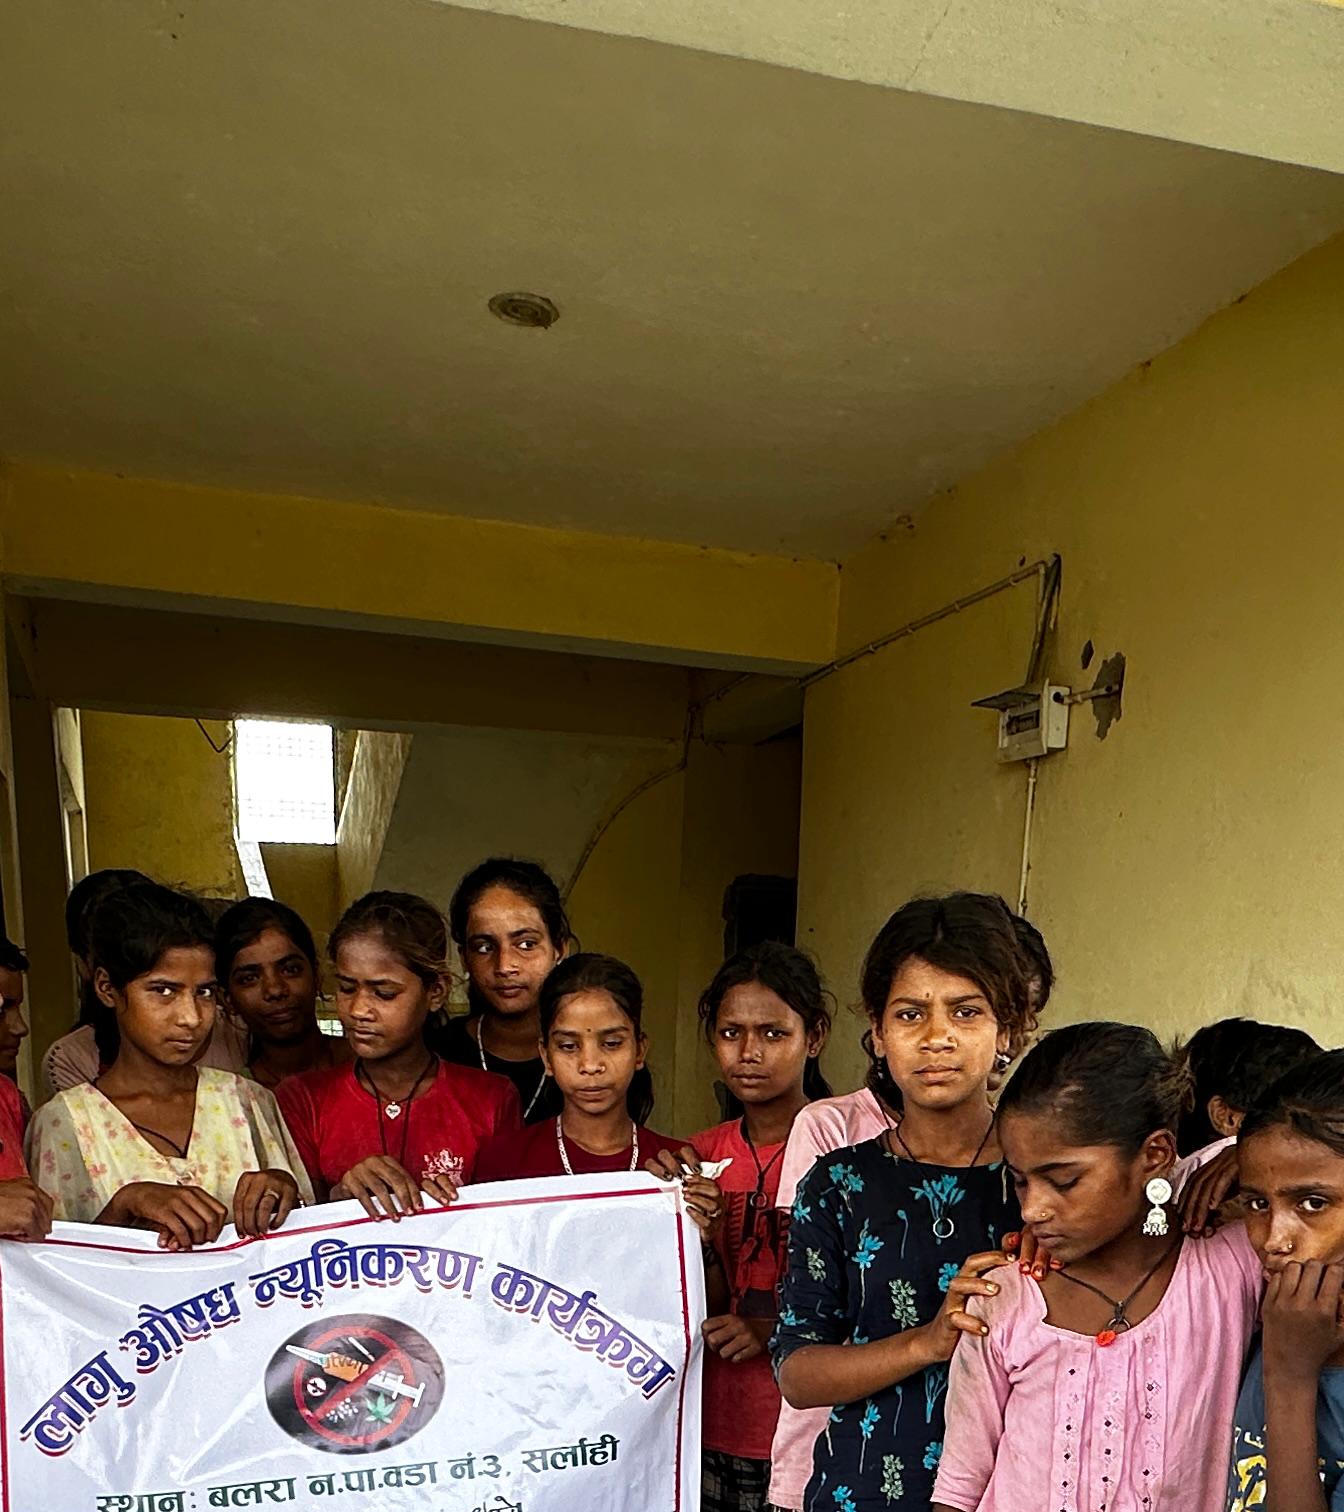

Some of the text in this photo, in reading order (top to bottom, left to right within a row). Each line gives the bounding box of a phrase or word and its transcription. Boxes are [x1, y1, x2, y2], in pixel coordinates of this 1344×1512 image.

[20, 1239, 675, 1456] लागु औषध न्यूनिकरण कार्यक्रम
[207, 1477, 297, 1508] बलरा
[522, 1434, 621, 1473] सर्लाही
